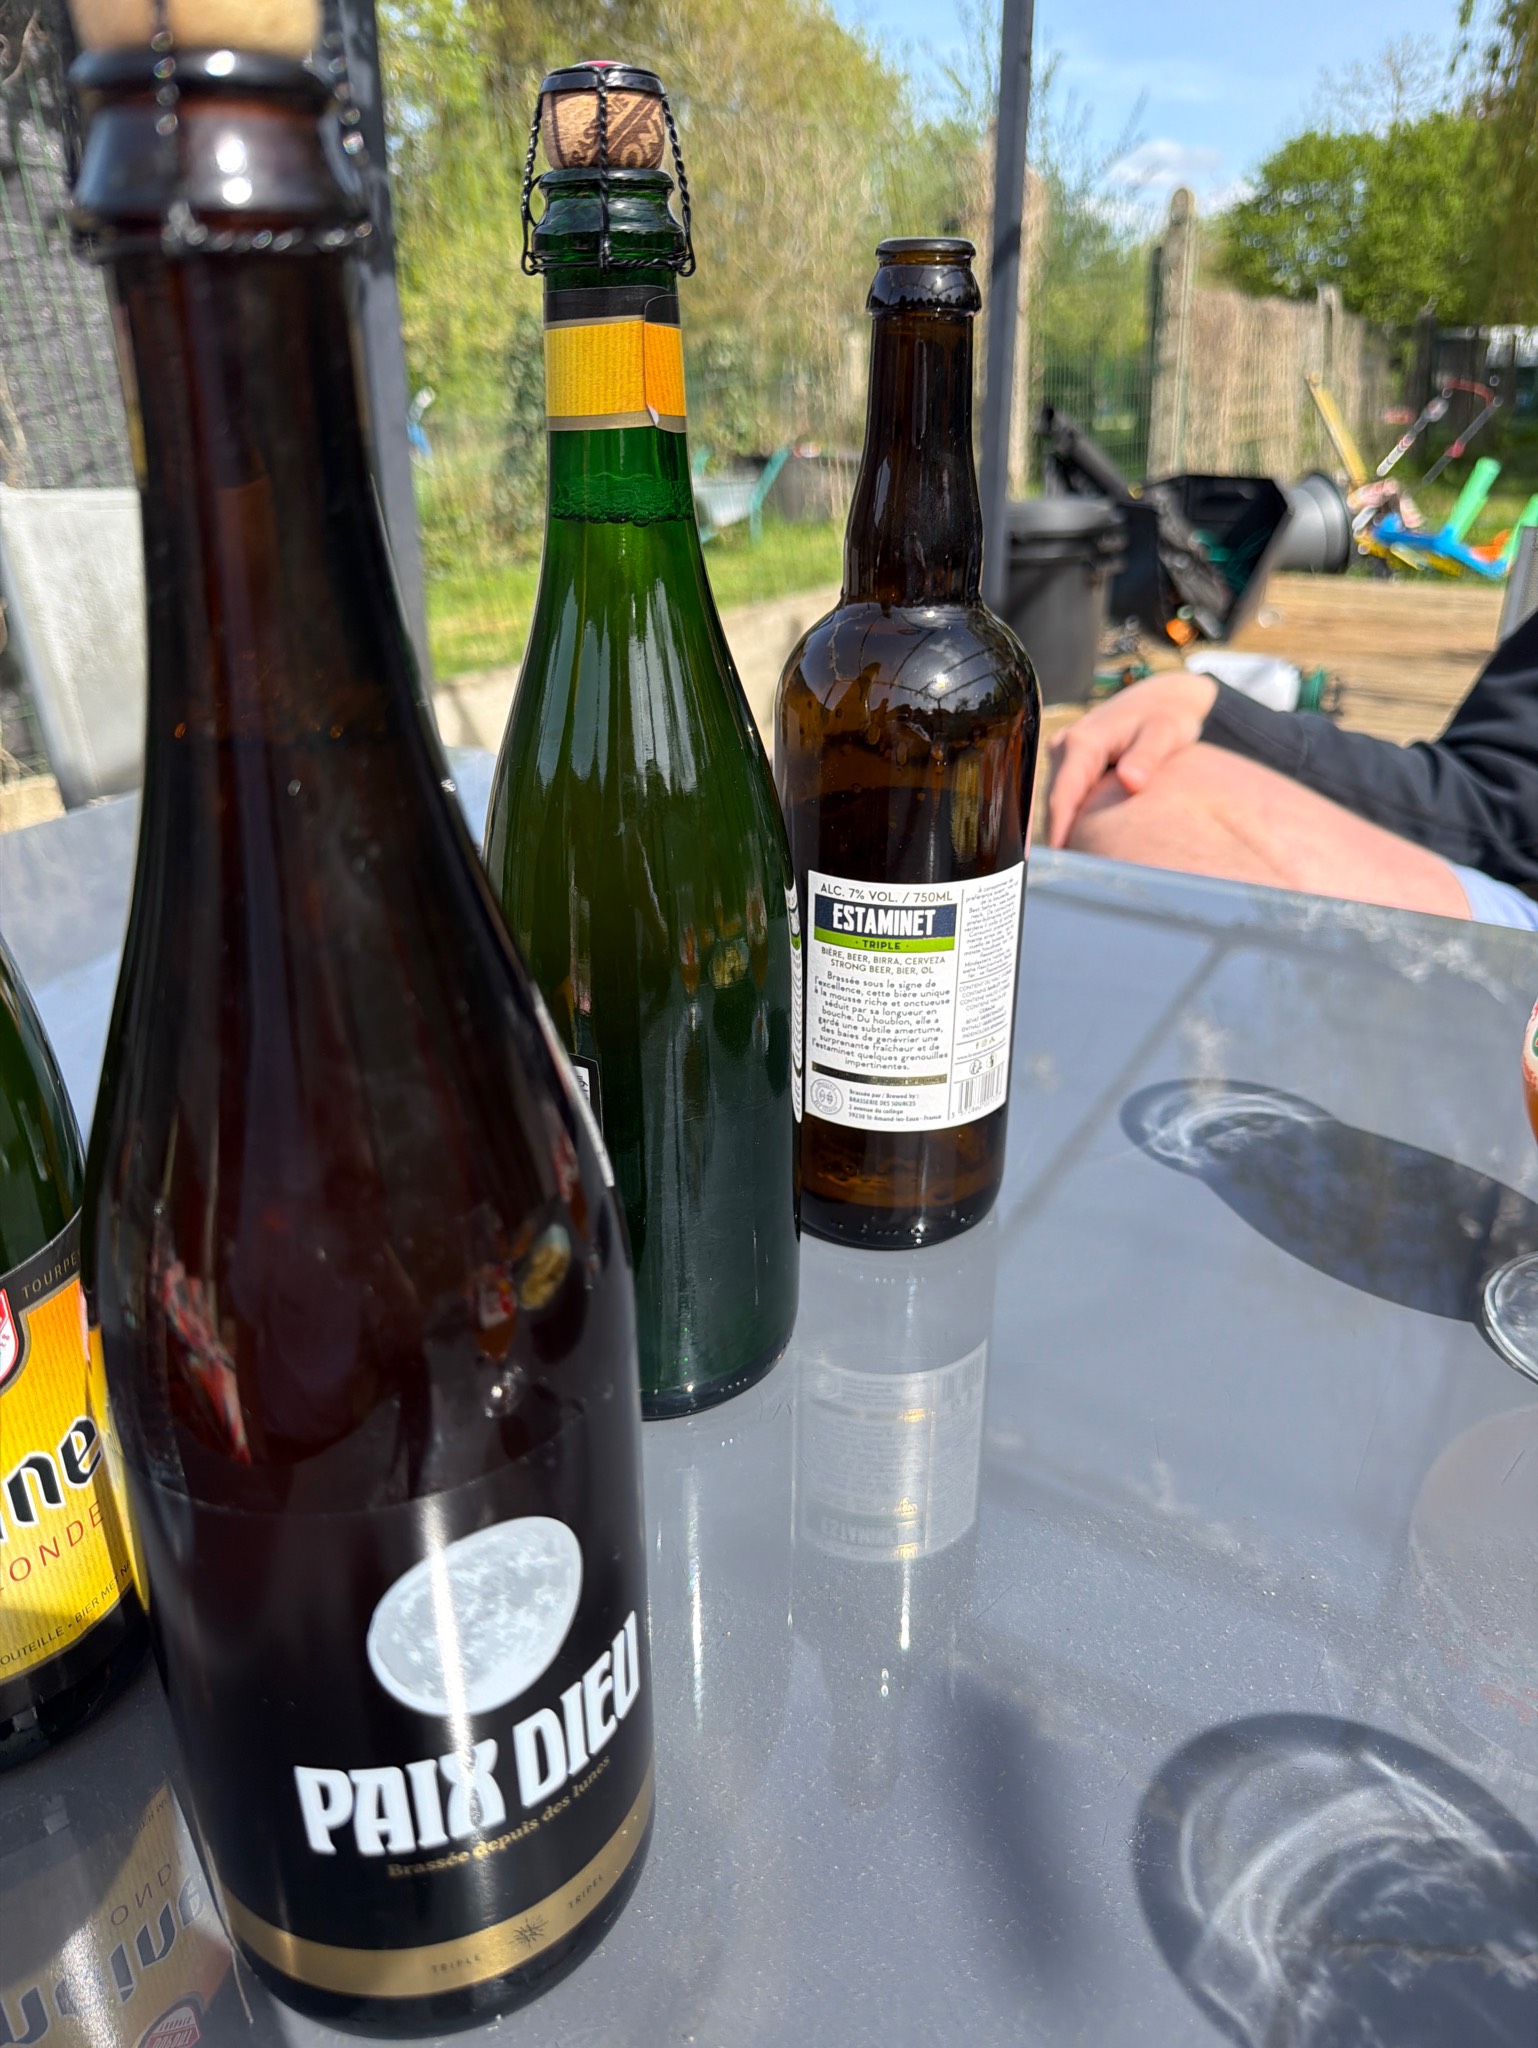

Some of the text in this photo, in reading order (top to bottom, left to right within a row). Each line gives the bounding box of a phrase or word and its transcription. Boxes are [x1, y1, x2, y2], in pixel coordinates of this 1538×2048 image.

[820, 883, 845, 897] ALC.
[849, 887, 865, 900] 7%
[869, 890, 898, 903] VOL.
[902, 892, 910, 904] /
[913, 891, 953, 903] 750ML
[832, 902, 936, 936] ESTAMINET
[862, 939, 901, 950] TRIPLE
[821, 946, 946, 966] BIÈRE, BEER, BIRRA, CERVEZA
[830, 959, 867, 972] STRONG
[869, 965, 894, 975] BEER,
[896, 966, 918, 976] BIER,
[814, 975, 950, 998] l'excellence, cette bière unique
[827, 970, 936, 991] Brassée sous le signe de
[821, 987, 827, 997] la
[829, 992, 862, 1004] mousse
[864, 997, 888, 1007] riche
[903, 998, 950, 1007] onctueuse
[821, 1005, 854, 1021] bouche.
[857, 1013, 870, 1023] Du
[873, 1015, 913, 1026] houblon,
[915, 1016, 931, 1024] elle
[824, 1000, 849, 1011] séduit
[852, 1006, 867, 1014] par
[882, 1007, 923, 1018] longueur
[821, 1024, 835, 1034] des
[837, 1028, 859, 1040] baies
[862, 1033, 873, 1041] de
[876, 1035, 919, 1045] genévrier
[842, 1023, 858, 1031] une
[861, 1024, 891, 1034] subtile
[894, 1026, 943, 1035] amertume,
[811, 1037, 948, 1063] l'estaminet quelques grenouilles
[820, 1034, 870, 1050] surprenante
[929, 1042, 940, 1051] de
[845, 1057, 910, 1070] impertinentes.
[22, 1249, 80, 1299] TOURPE
[0, 1415, 102, 1543] ne
[0, 1500, 104, 1590] ONDE
[0, 1623, 66, 1666] OUTEILLE
[74, 1597, 100, 1624] BIER
[100, 1575, 120, 1600] MET
[293, 1610, 641, 1857] PAIX DIEU
[387, 1755, 611, 1878] Brassée depuis des lunes
